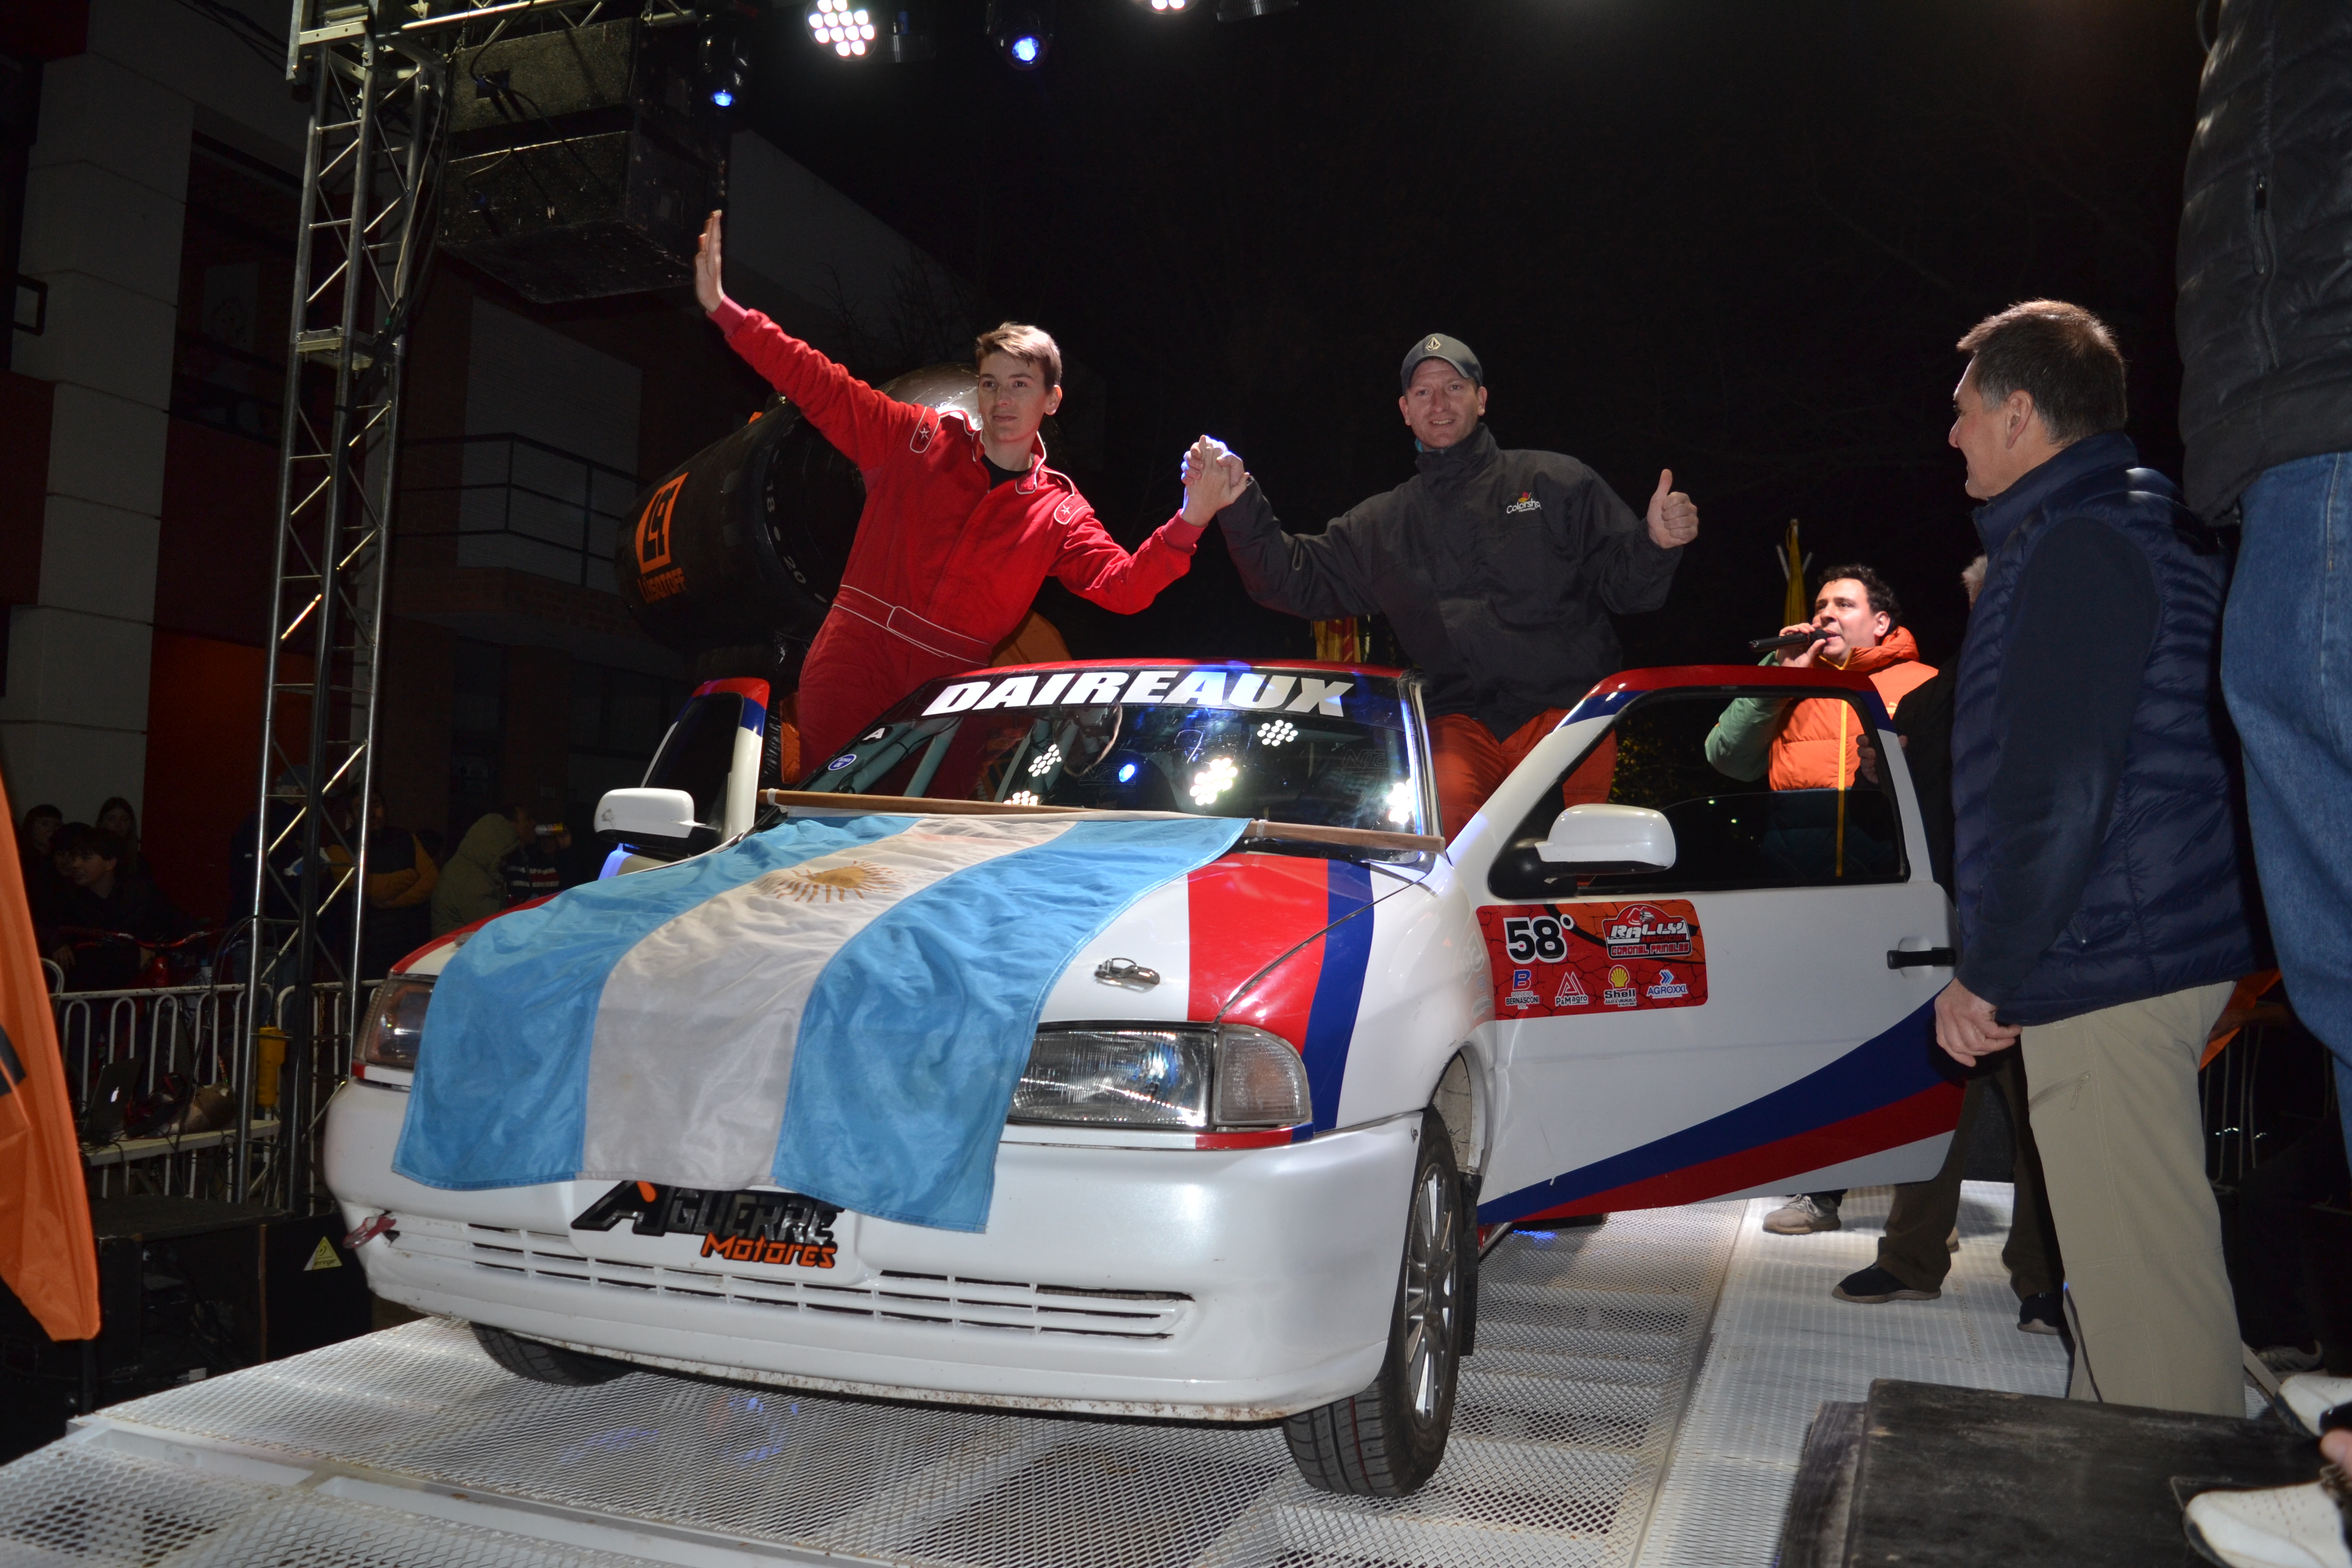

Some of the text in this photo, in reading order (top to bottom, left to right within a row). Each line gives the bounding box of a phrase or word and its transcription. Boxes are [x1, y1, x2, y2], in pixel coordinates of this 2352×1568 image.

[782, 555, 807, 584] 20
[921, 670, 1355, 718] DAIREAUX
[862, 727, 886, 741] A
[1610, 919, 1687, 939] RALLY
[1611, 942, 1690, 956] CORONEL PRINGLES
[1506, 996, 1539, 1005] BERNASCONI
[1604, 989, 1635, 999] Shell
[700, 1231, 838, 1269] Motores
